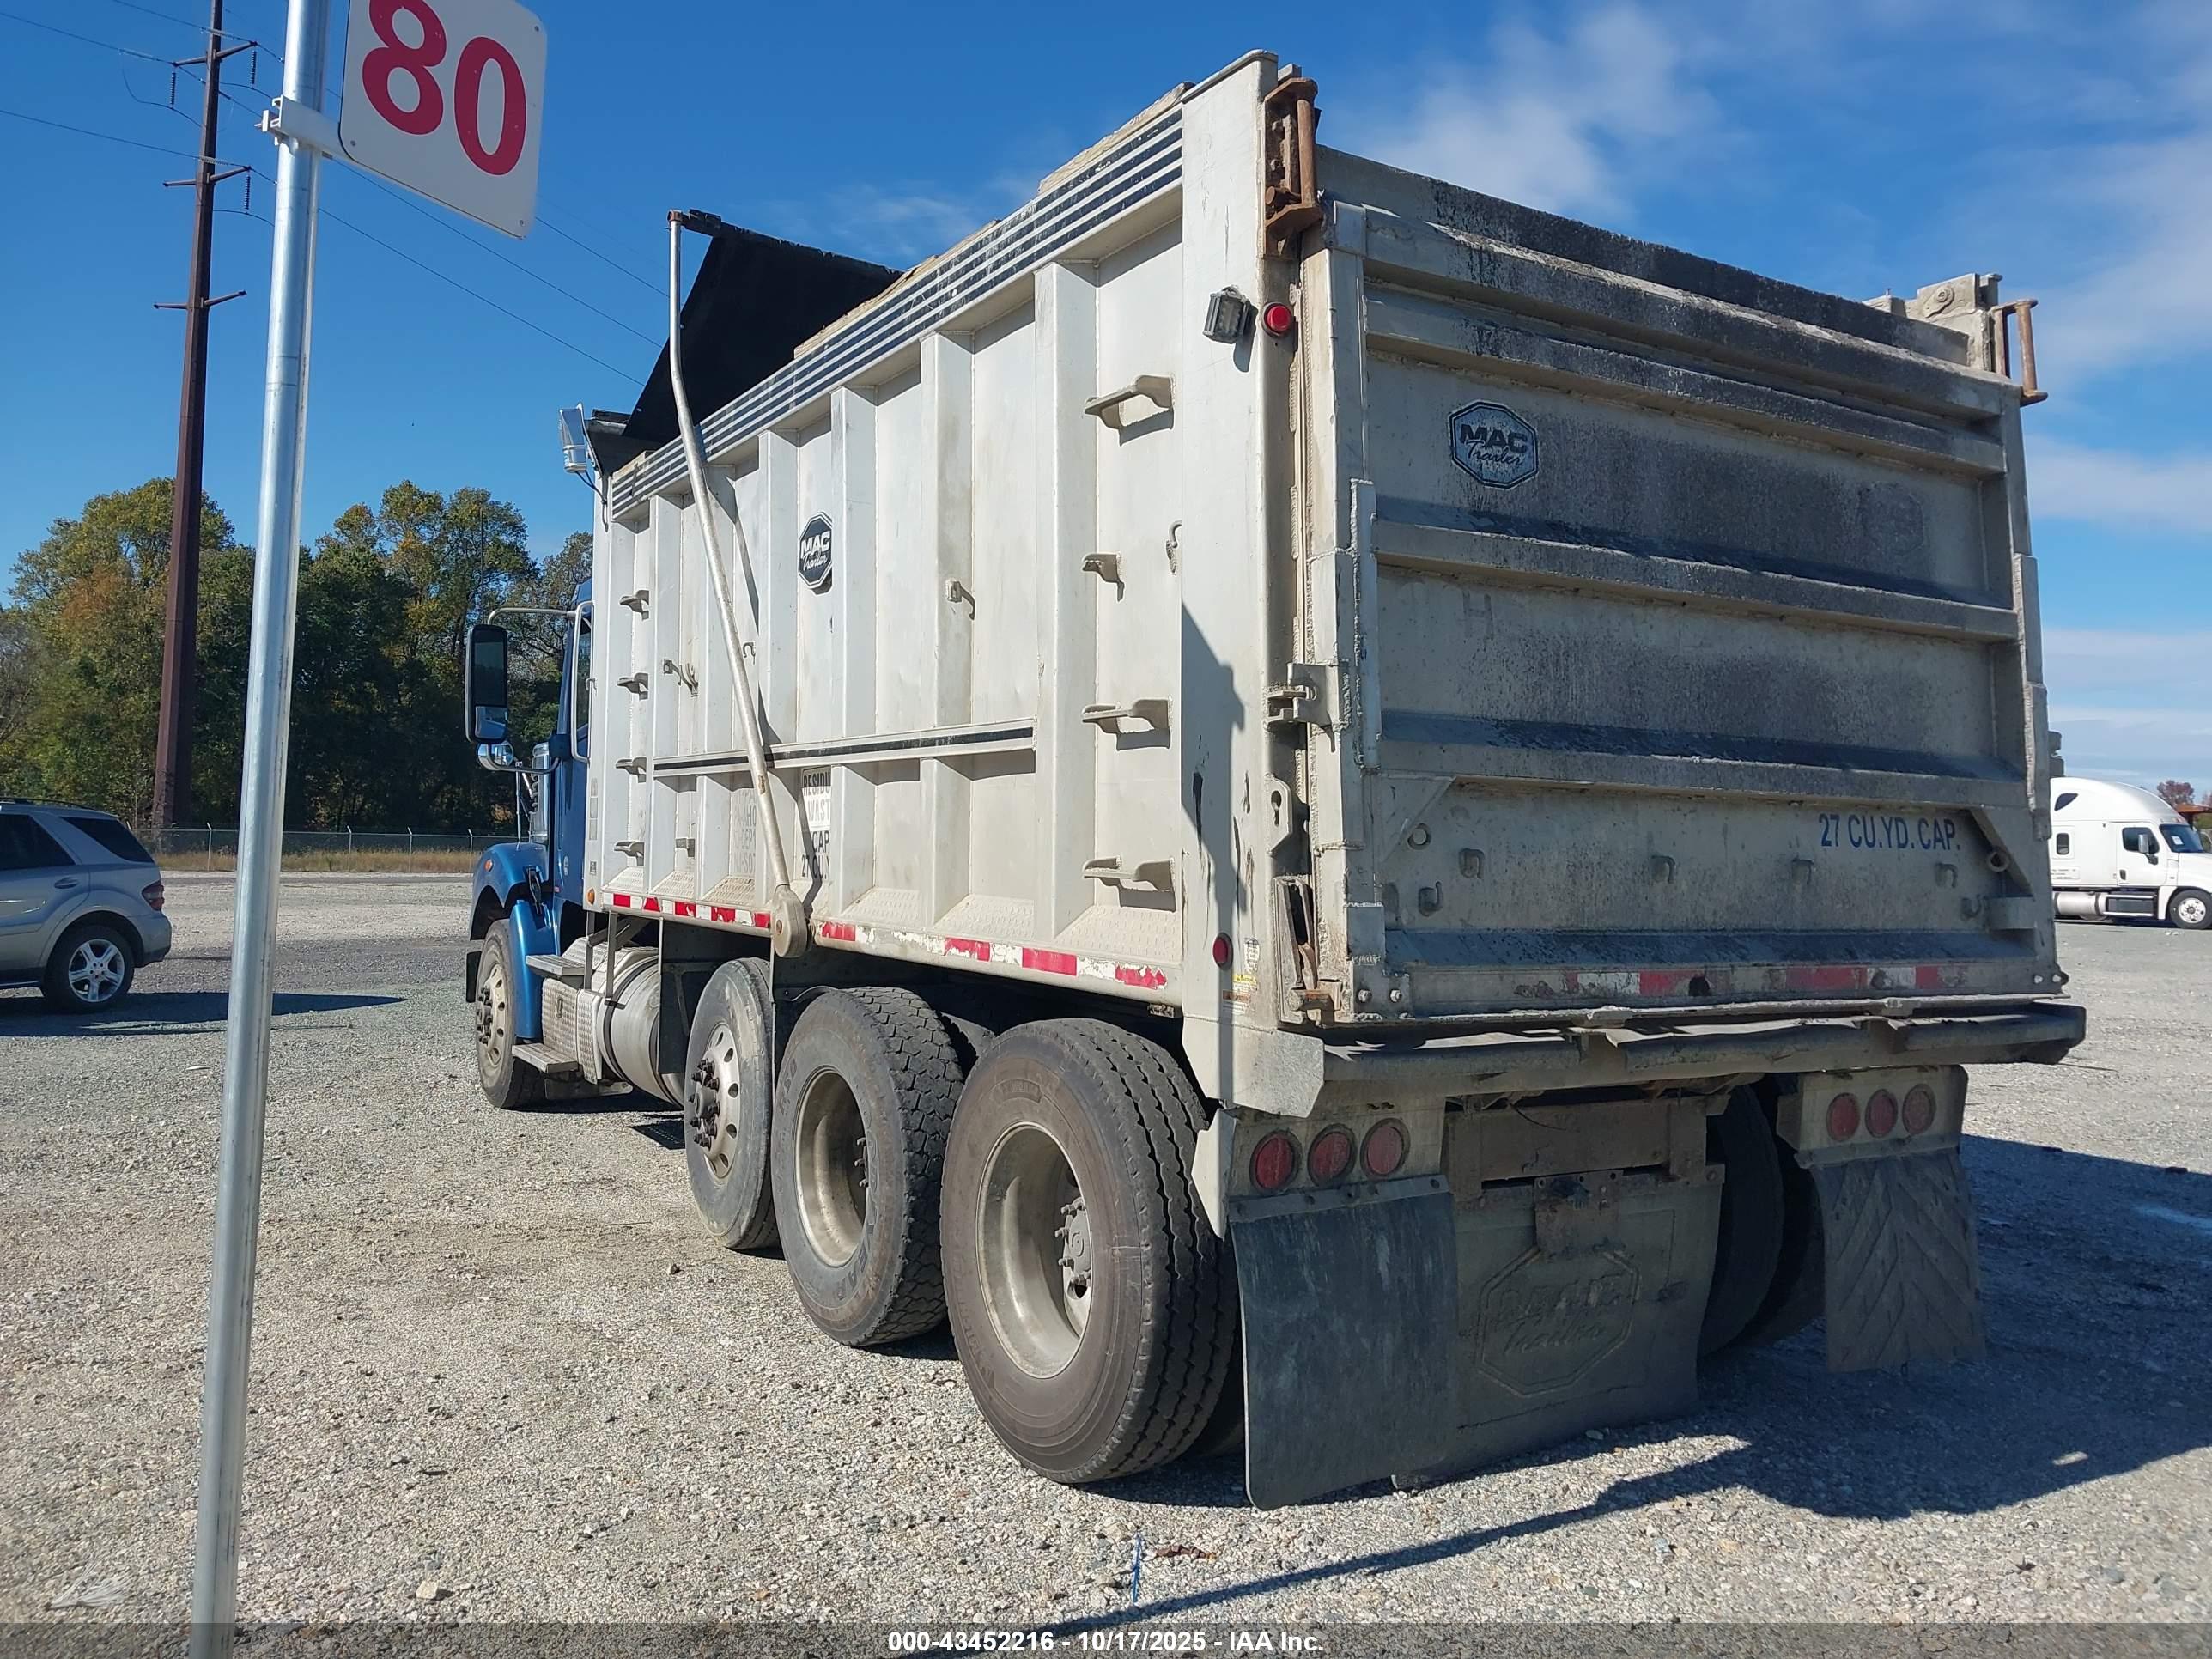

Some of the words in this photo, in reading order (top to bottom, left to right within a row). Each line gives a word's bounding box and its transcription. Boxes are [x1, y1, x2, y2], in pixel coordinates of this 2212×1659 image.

[362, 0, 526, 176] 80
[1460, 423, 1528, 453] MAC
[1465, 440, 1524, 465] Trailer
[800, 531, 830, 559] MAC
[1819, 814, 1840, 848] 27
